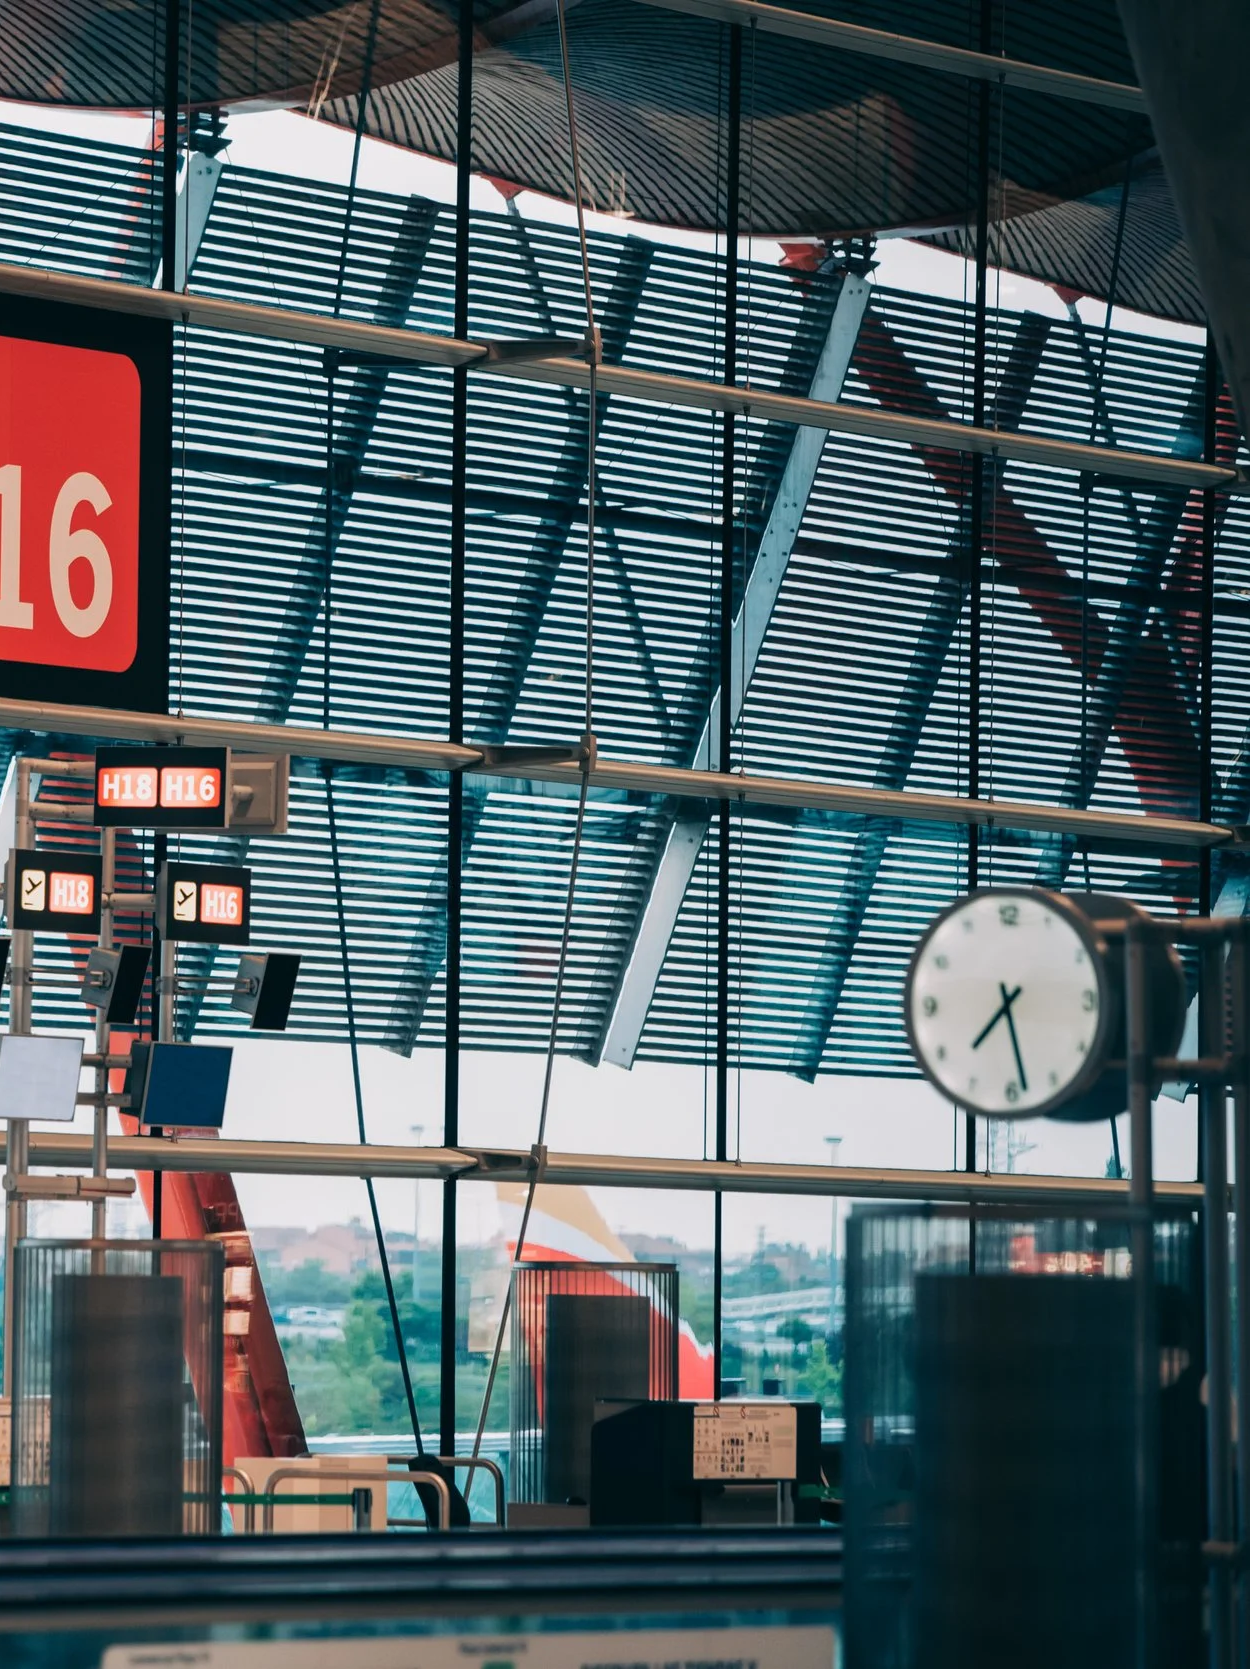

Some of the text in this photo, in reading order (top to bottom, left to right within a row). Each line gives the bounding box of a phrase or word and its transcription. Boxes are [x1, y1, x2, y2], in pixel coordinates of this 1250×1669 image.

[103, 774, 216, 801] H18 H16
[54, 878, 89, 908] H18
[205, 889, 238, 919] H16
[999, 905, 1019, 926] 12
[923, 994, 938, 1017] 9
[1082, 989, 1097, 1011] 3
[1005, 1081, 1020, 1103] 6
